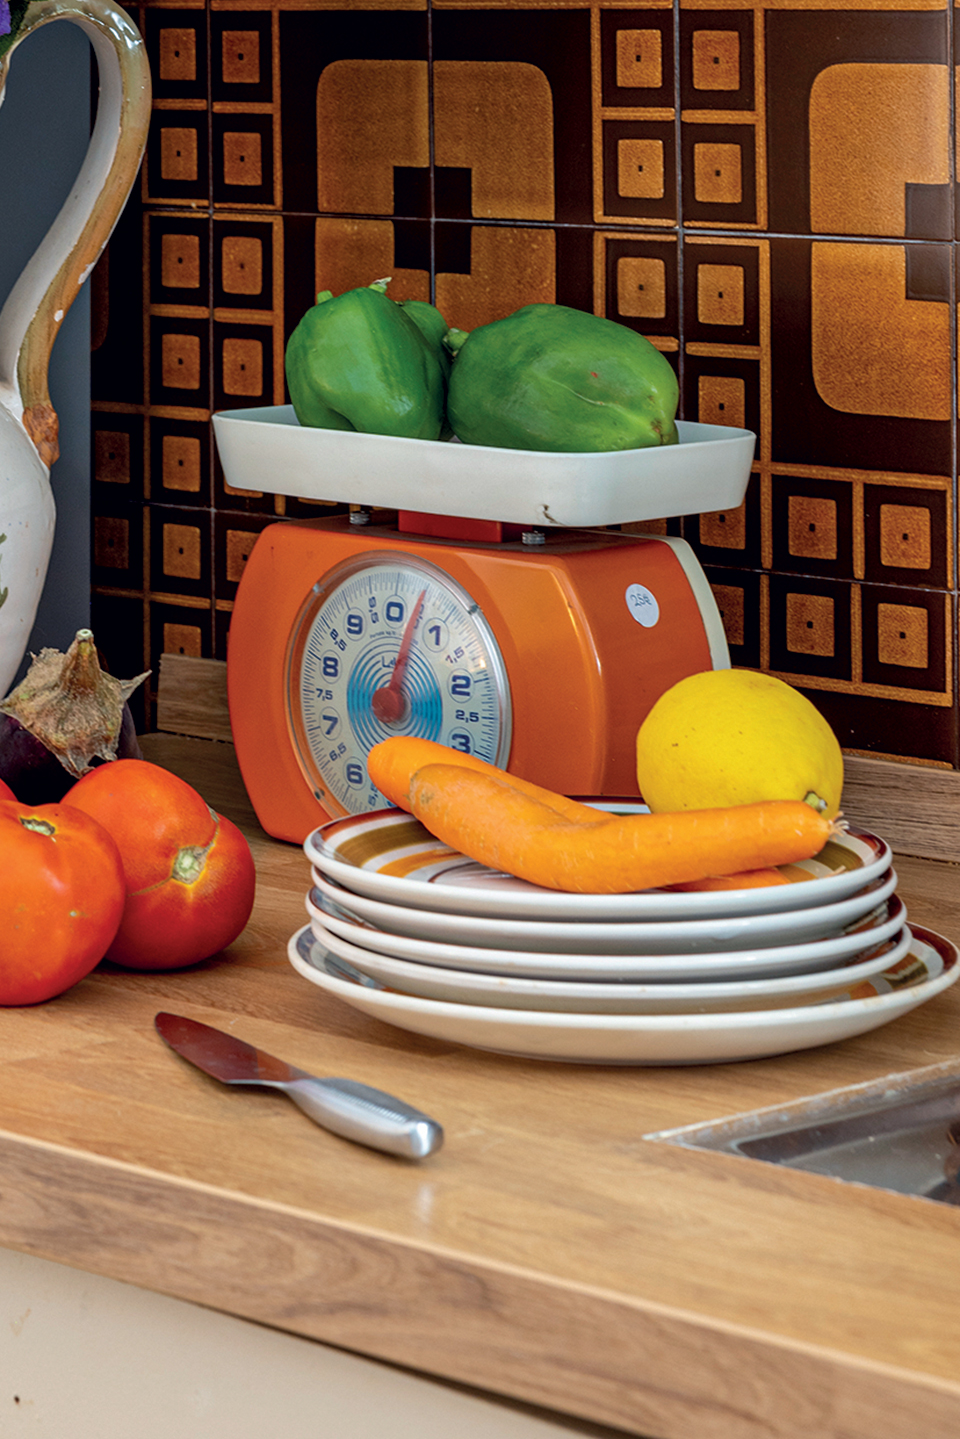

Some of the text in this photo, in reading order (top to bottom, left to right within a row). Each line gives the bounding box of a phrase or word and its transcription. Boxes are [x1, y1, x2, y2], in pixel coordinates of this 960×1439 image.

[385, 601, 405, 623] 0
[346, 614, 364, 636] 9
[428, 625, 442, 646] 1
[329, 627, 348, 652] 8,5
[445, 646, 466, 665] 1,5
[322, 656, 339, 678] 8
[315, 688, 334, 701] 7,5
[451, 674, 472, 697] 2
[322, 714, 339, 736] 7
[455, 709, 480, 724] 2,5
[329, 742, 348, 762] 6,5
[451, 733, 471, 755] 3
[346, 763, 364, 785] 6
